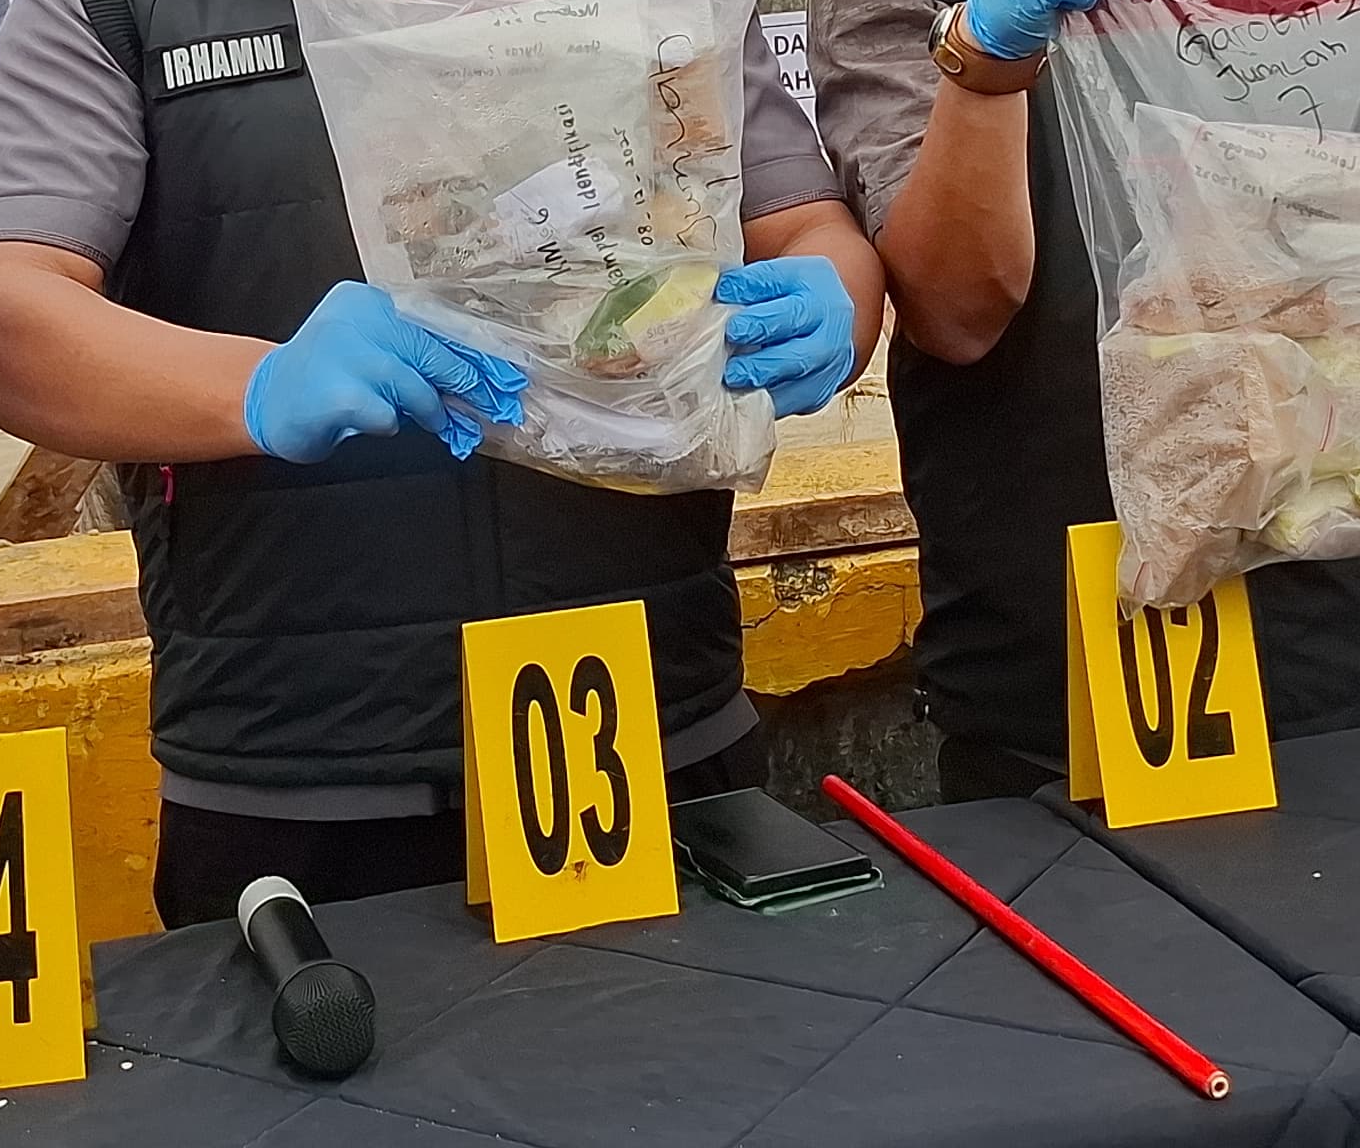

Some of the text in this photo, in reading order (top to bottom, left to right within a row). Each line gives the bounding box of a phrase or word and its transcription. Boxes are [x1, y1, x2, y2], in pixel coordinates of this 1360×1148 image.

[162, 33, 286, 90] IRHAMNI
[1277, 85, 1327, 145] 7
[536, 240, 572, 280] KM
[1117, 589, 1236, 768] 02
[511, 654, 631, 876] 03
